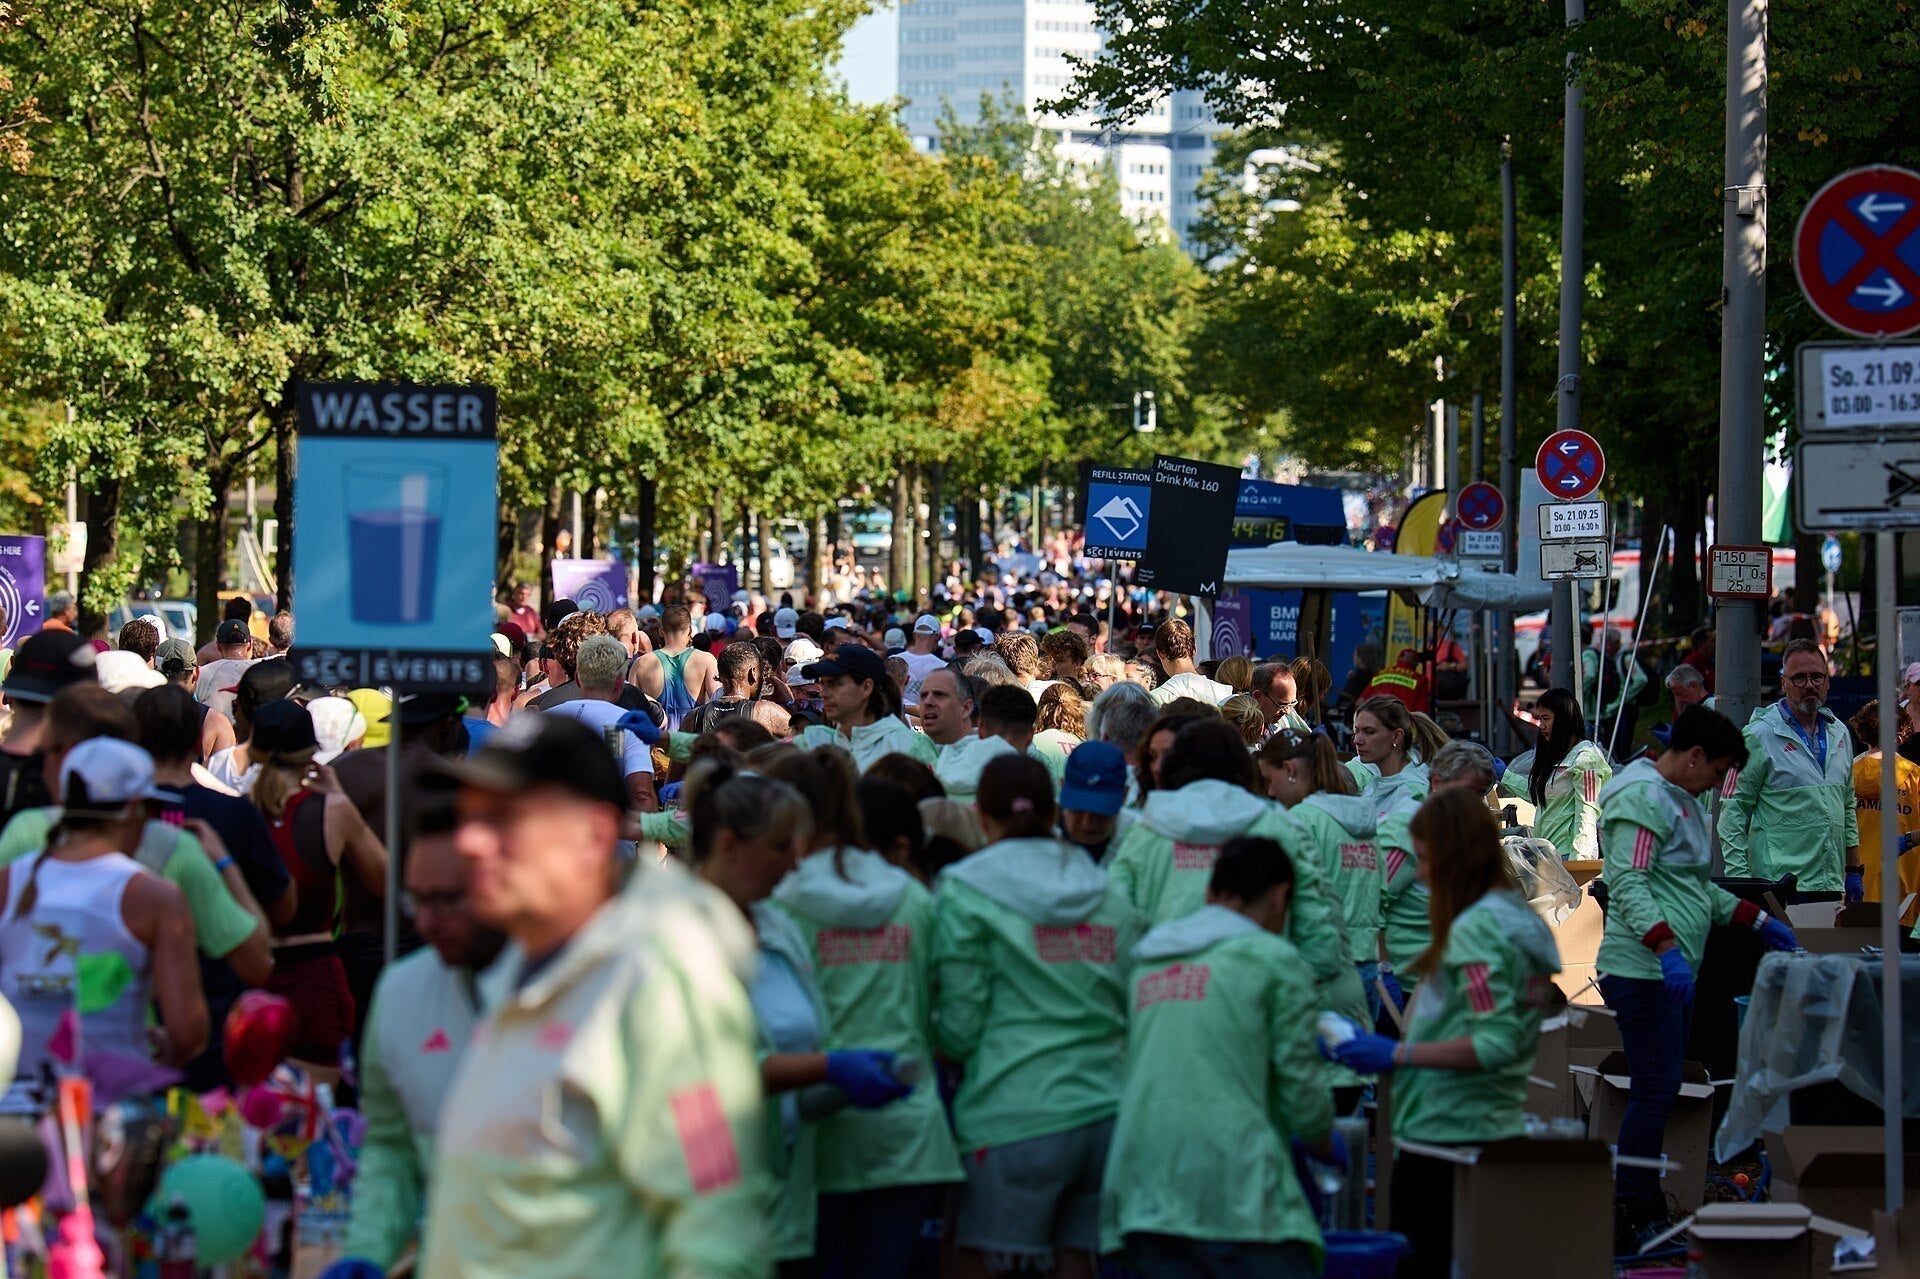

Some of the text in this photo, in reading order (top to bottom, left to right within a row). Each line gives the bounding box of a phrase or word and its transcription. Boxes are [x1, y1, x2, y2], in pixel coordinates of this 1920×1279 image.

[1830, 364, 1859, 388] So.
[310, 391, 484, 432] WASSER
[1158, 459, 1198, 476] Maurten
[1092, 470, 1150, 482] REFILL STATION
[1155, 472, 1220, 492] Drink Mix 160
[1553, 509, 1599, 521] So. 21.09.25
[3, 546, 22, 556] HERE
[1086, 546, 1142, 559] SCC EVENTS
[1713, 551, 1746, 563] H150
[1729, 580, 1751, 592] 25.0
[301, 651, 482, 685] SCC EVENTS
